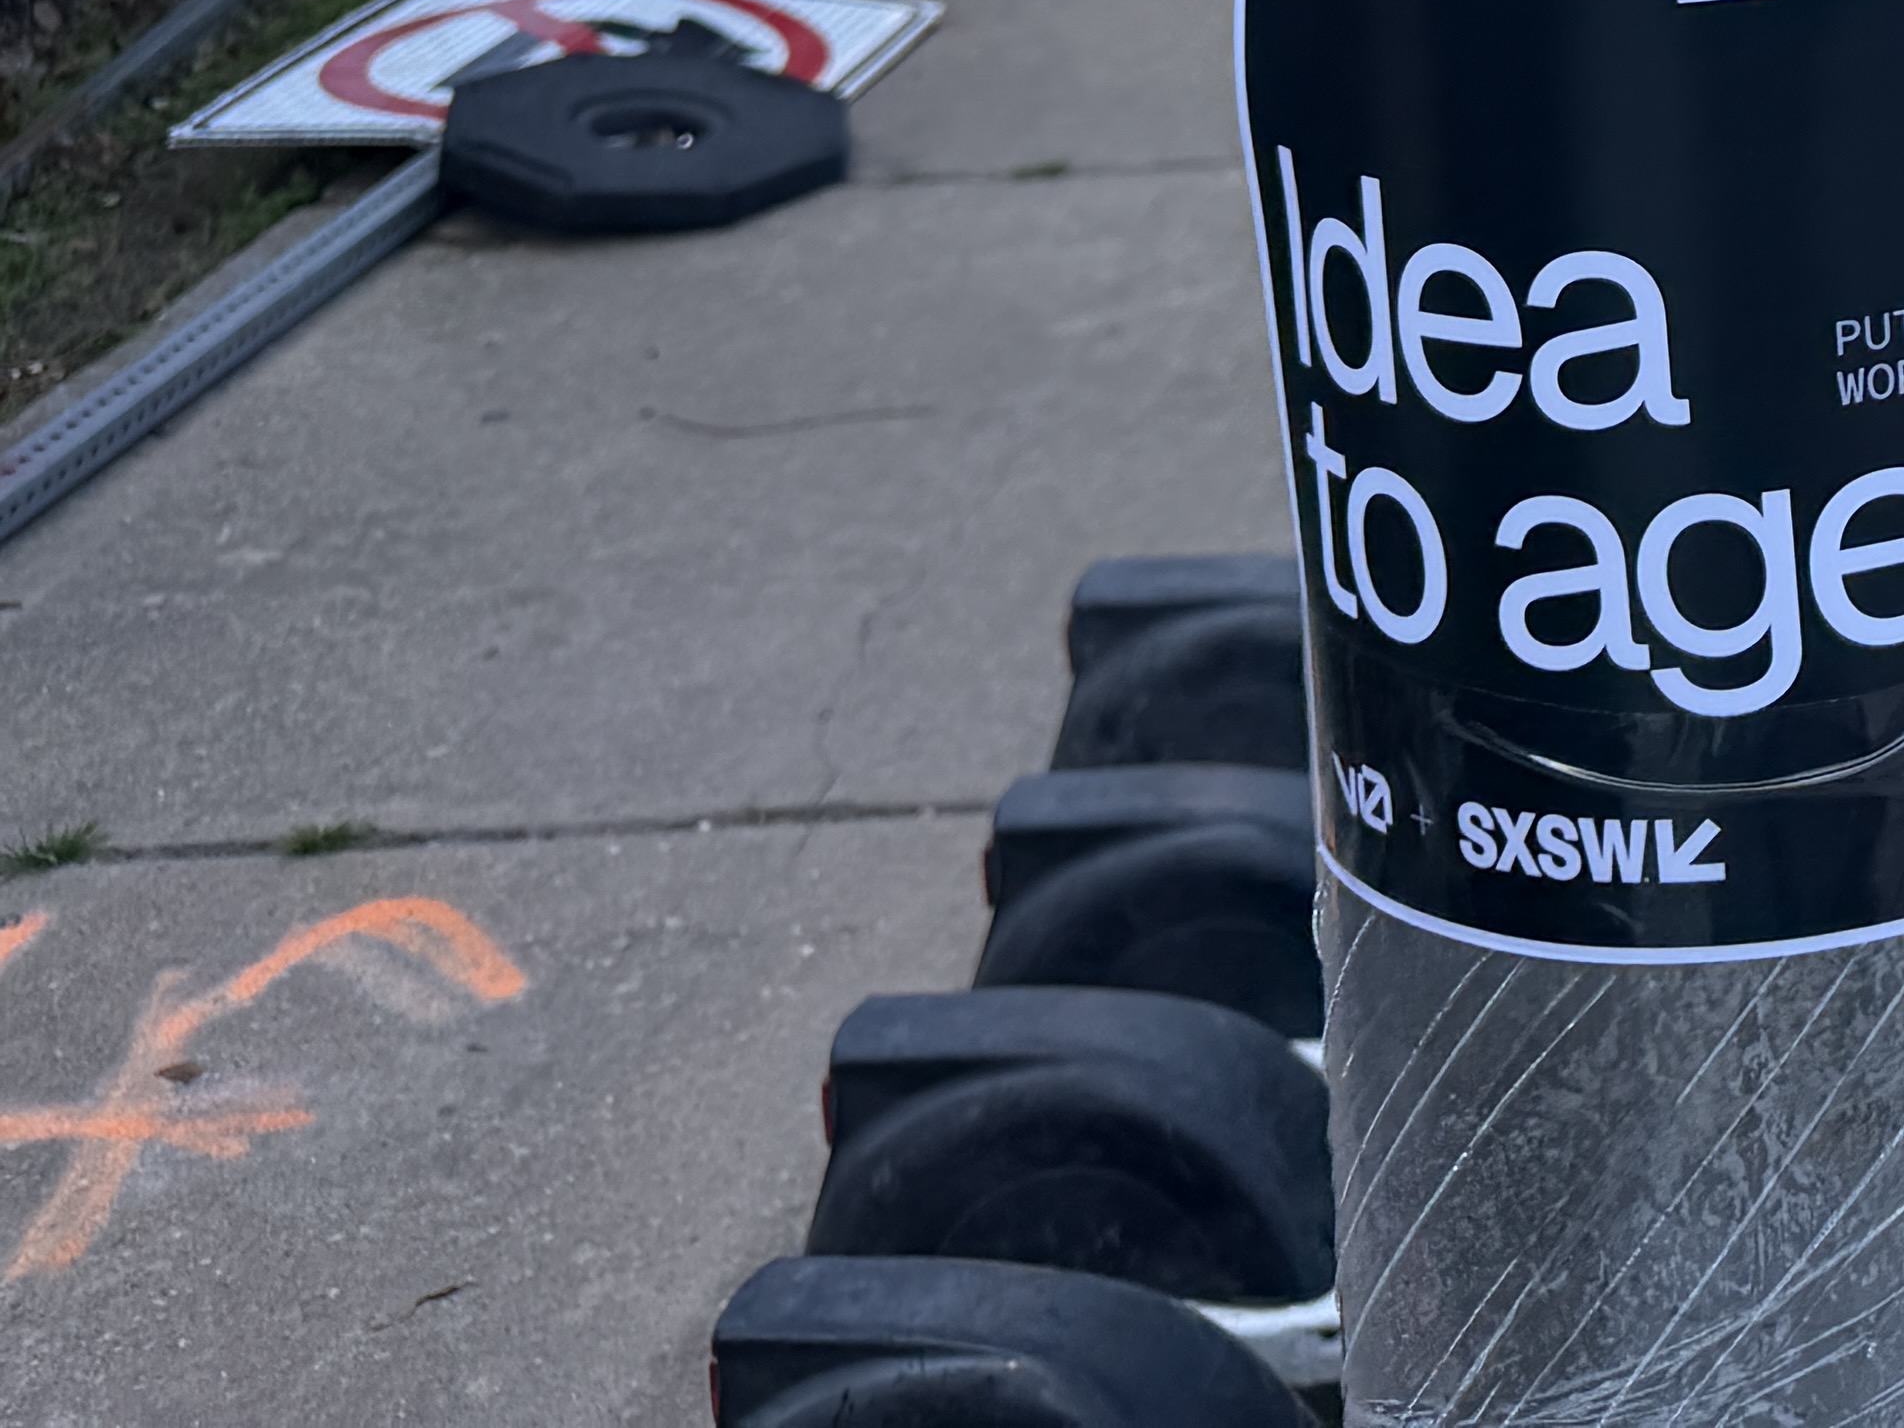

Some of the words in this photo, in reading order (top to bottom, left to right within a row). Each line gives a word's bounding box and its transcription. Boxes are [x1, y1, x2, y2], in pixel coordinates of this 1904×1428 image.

[1276, 143, 1690, 432] Idea
[1306, 401, 1448, 644] to
[1458, 801, 1647, 884] SXSW
